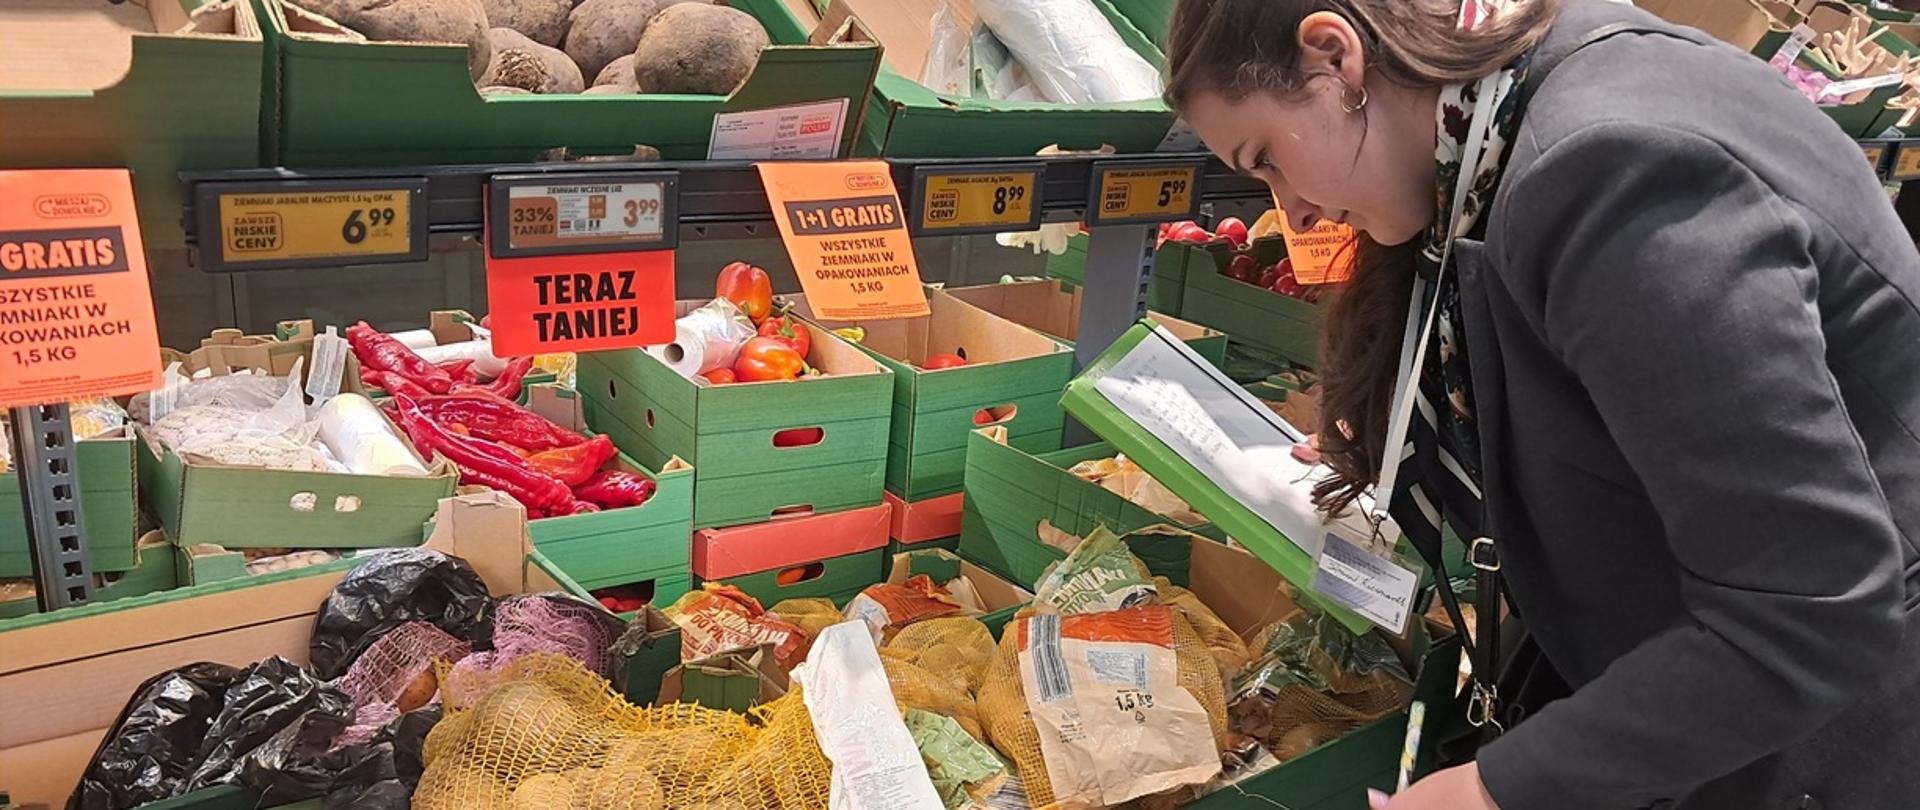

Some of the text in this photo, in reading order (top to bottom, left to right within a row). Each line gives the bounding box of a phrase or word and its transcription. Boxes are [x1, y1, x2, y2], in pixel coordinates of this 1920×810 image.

[930, 200, 955, 208] NISKIE
[1105, 200, 1126, 210] CENY
[234, 216, 276, 225] ZAWSZE
[514, 207, 553, 223] 33%
[796, 203, 895, 230] 1+1 GRATIS
[929, 209, 955, 219] CENY
[234, 225, 277, 236] NISKIE
[513, 224, 553, 236] TANIEJ
[235, 237, 278, 249] CENY
[820, 237, 887, 252] WSZYSTKIE
[0, 237, 116, 272] GRATIS
[821, 251, 895, 266] ZIEMNIAKI W
[815, 264, 910, 281] OPAKOWANIACH
[533, 270, 637, 306] TERAZ
[850, 281, 884, 294] 1,5 KG
[84, 302, 107, 318] W
[532, 306, 639, 342] TANIEJ
[12, 345, 77, 368] 1,5 KG
[1115, 693, 1154, 711] 1,5 kg
